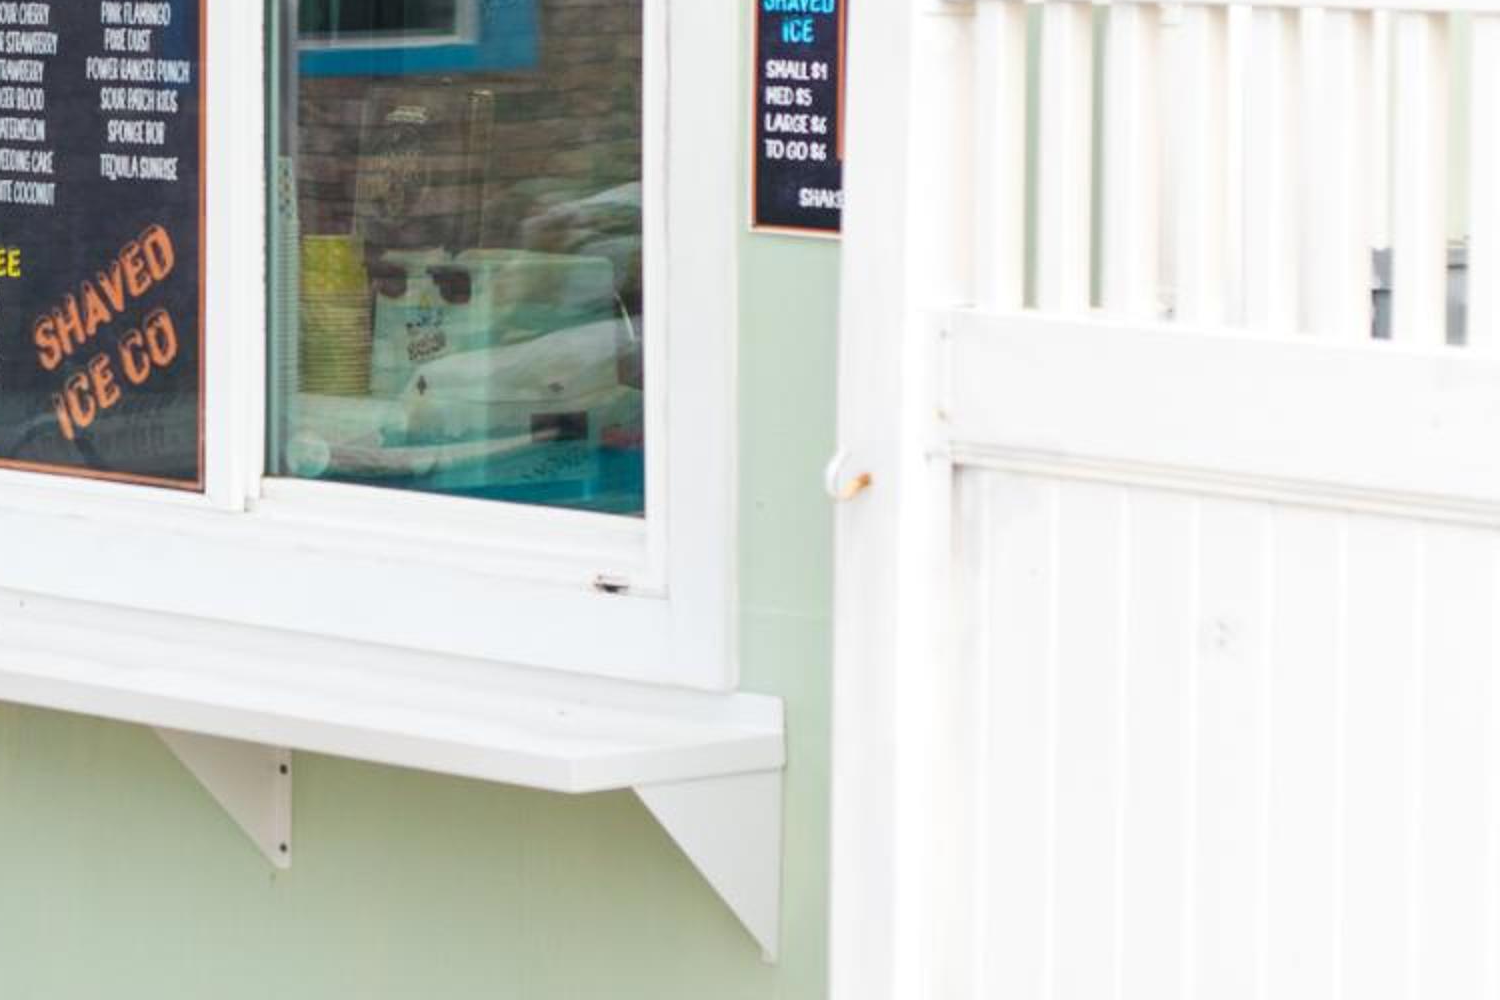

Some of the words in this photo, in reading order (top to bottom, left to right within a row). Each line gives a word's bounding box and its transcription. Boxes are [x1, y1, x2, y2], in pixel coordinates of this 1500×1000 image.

[19, 1, 51, 26] CHERRY
[100, 1, 123, 26] PINK
[123, 1, 172, 26] FLAMINGO
[6, 29, 59, 55] STRAWBERRY
[127, 27, 153, 53] DUST
[781, 18, 816, 43] ICE
[85, 56, 119, 81] POWER
[120, 57, 156, 82] RANGER
[157, 59, 191, 84] PUNCH
[765, 59, 810, 81] SMALL
[16, 86, 45, 111] BLOOD
[100, 87, 126, 111] SOUR
[127, 87, 155, 112] PATCH
[156, 88, 179, 114] KIDS
[764, 85, 795, 106] MED
[795, 86, 813, 107] $5
[107, 119, 145, 144] SPONGE
[145, 120, 166, 145] BOB
[764, 111, 810, 135] LARGE
[810, 114, 828, 135] $6
[31, 148, 56, 174] CAKE
[764, 138, 785, 160] TO
[785, 140, 809, 161] GO
[810, 141, 828, 162] $6
[99, 153, 138, 182] TEQUILA
[139, 155, 179, 181] SUNRISE
[14, 179, 56, 206] COCONUT
[34, 224, 176, 371] SHAVED
[53, 352, 122, 441] ICE
[118, 307, 180, 385] CO
